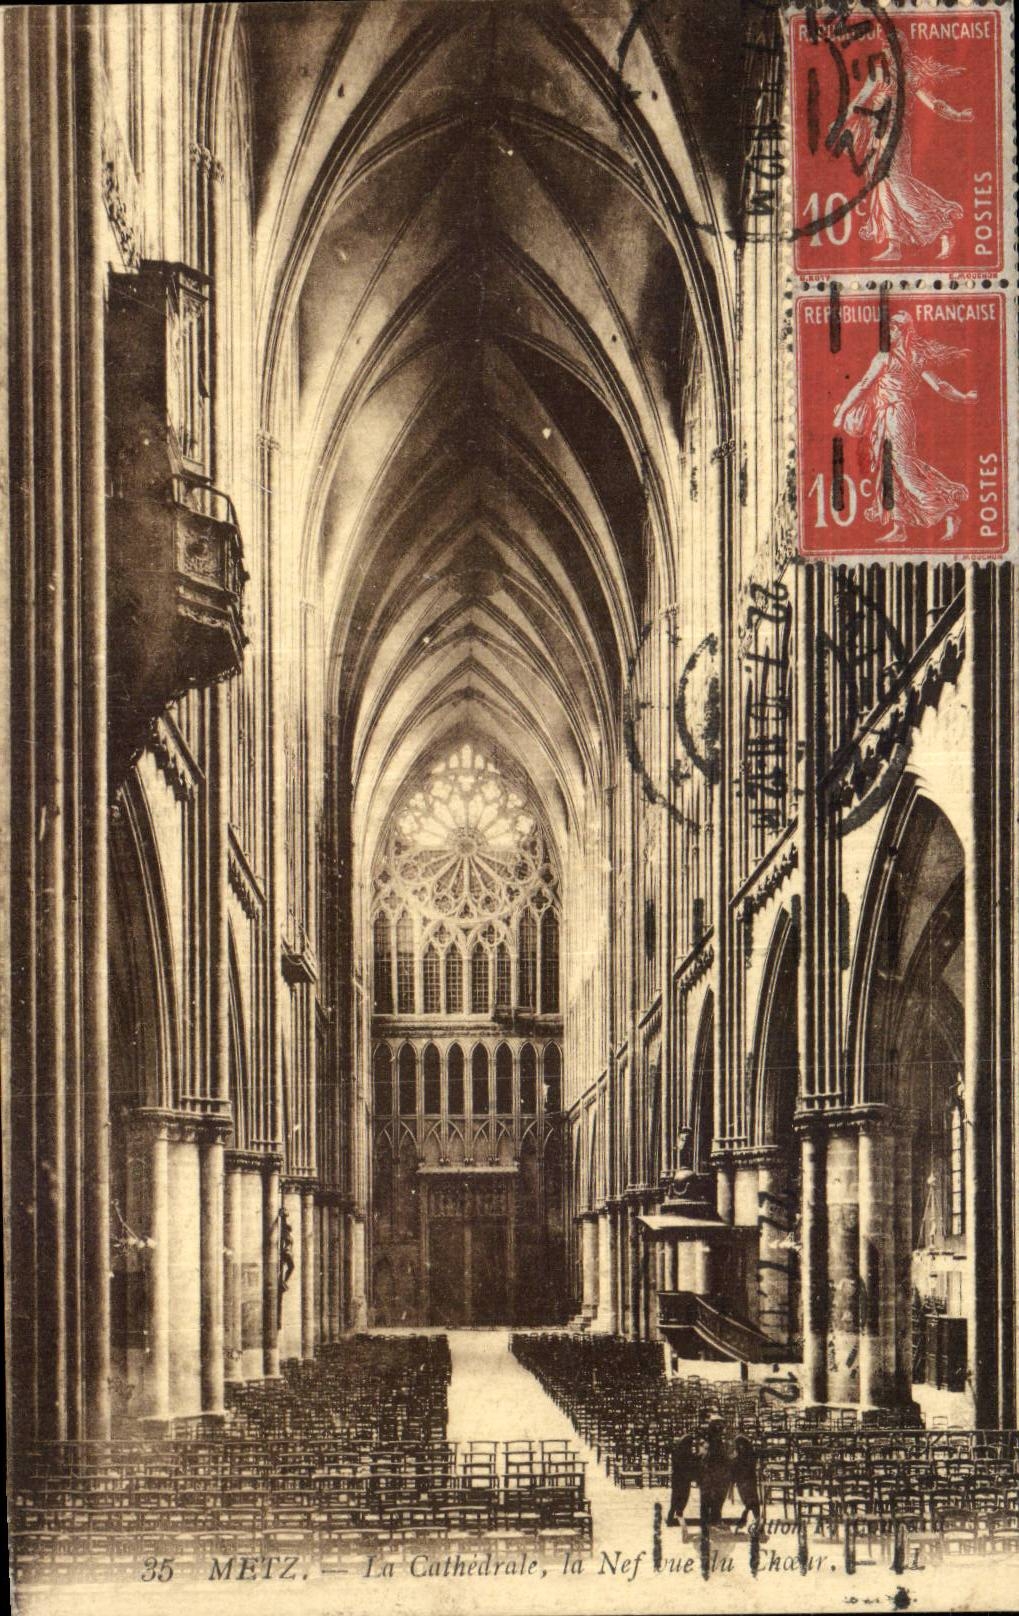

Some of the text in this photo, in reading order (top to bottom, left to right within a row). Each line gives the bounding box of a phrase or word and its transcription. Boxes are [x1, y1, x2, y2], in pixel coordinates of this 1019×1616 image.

[974, 171, 993, 256] POSTES
[804, 303, 996, 325] REPBLIQU FRANÇAISE
[979, 452, 998, 538] POSTES
